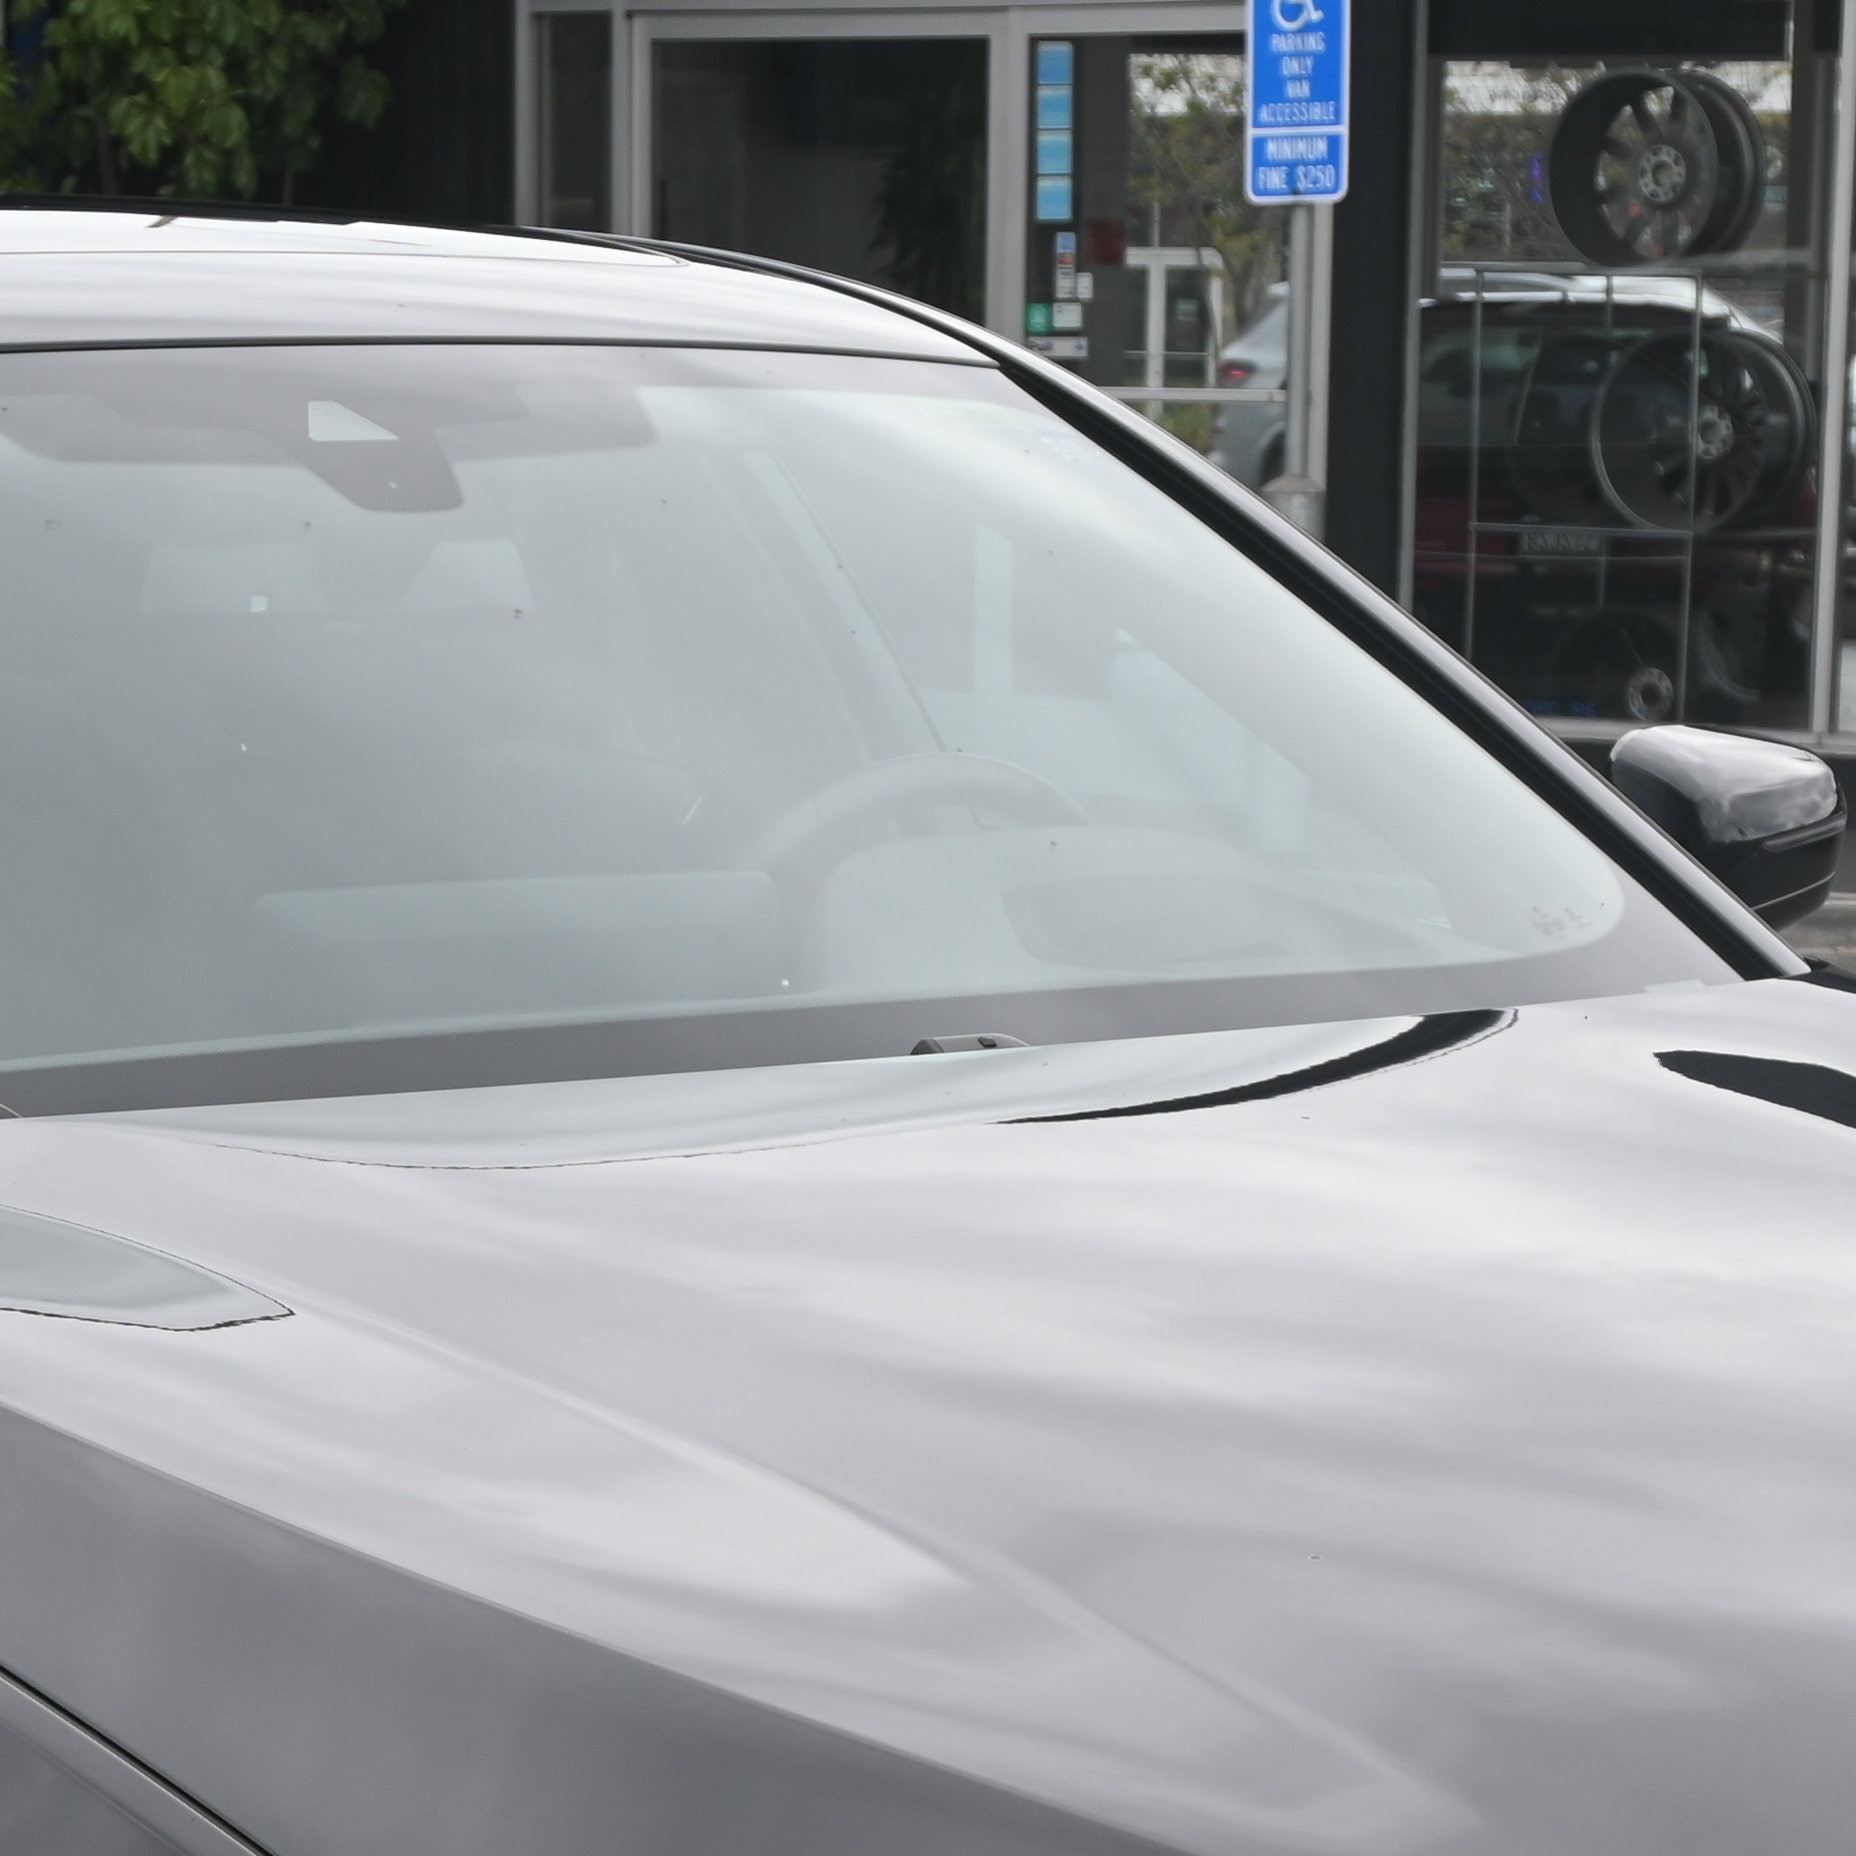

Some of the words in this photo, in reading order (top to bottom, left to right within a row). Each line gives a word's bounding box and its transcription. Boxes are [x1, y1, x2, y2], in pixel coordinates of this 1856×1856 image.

[1271, 32, 1326, 53] PARKING
[1281, 56, 1314, 76] ONLY
[1286, 79, 1311, 98] VAN
[1260, 101, 1336, 122] ACCESSIBLE
[1266, 137, 1328, 161] MINIMUM
[1258, 167, 1288, 190] FINE
[1296, 164, 1336, 189] $250
